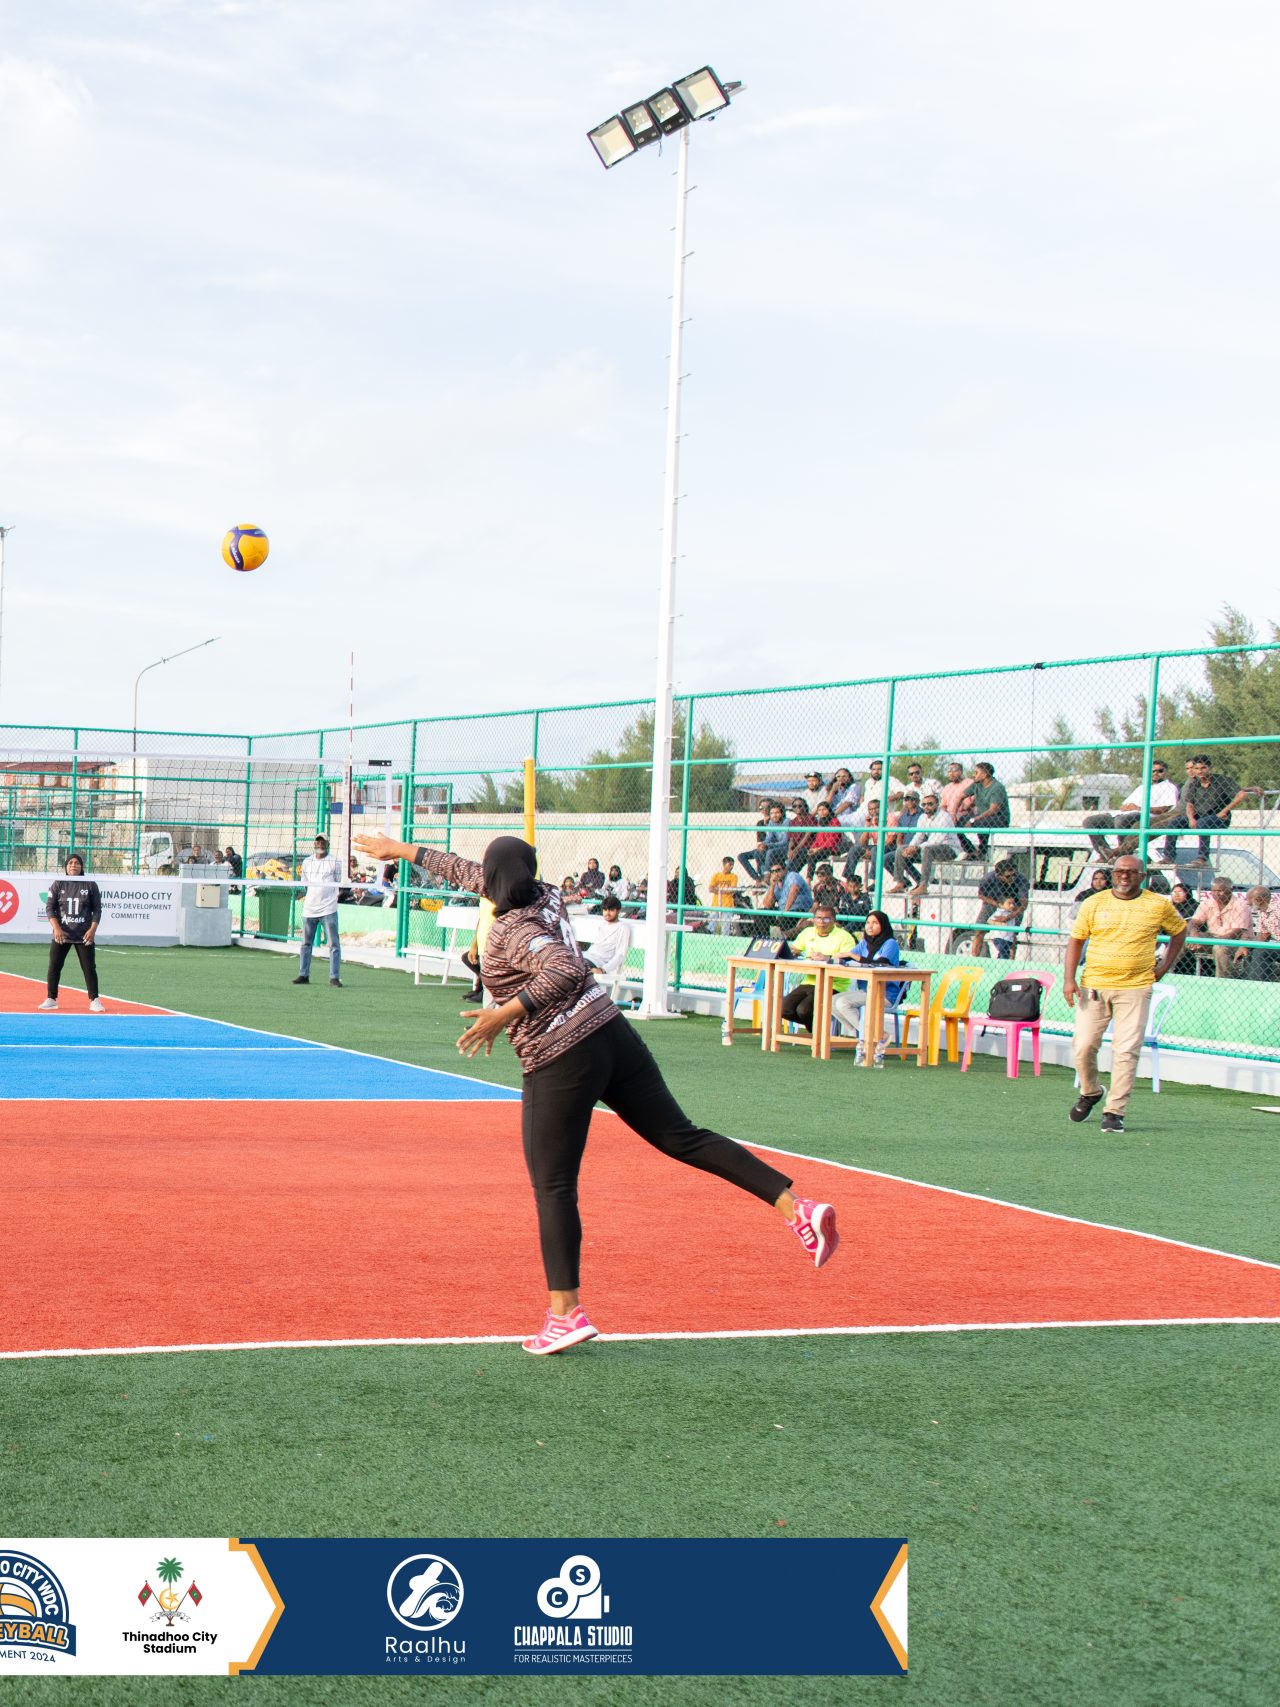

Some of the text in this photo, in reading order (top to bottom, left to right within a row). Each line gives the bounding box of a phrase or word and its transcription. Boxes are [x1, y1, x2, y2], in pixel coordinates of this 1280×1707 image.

[100, 890, 173, 900] INADHOO CITY
[67, 897, 80, 915] 11
